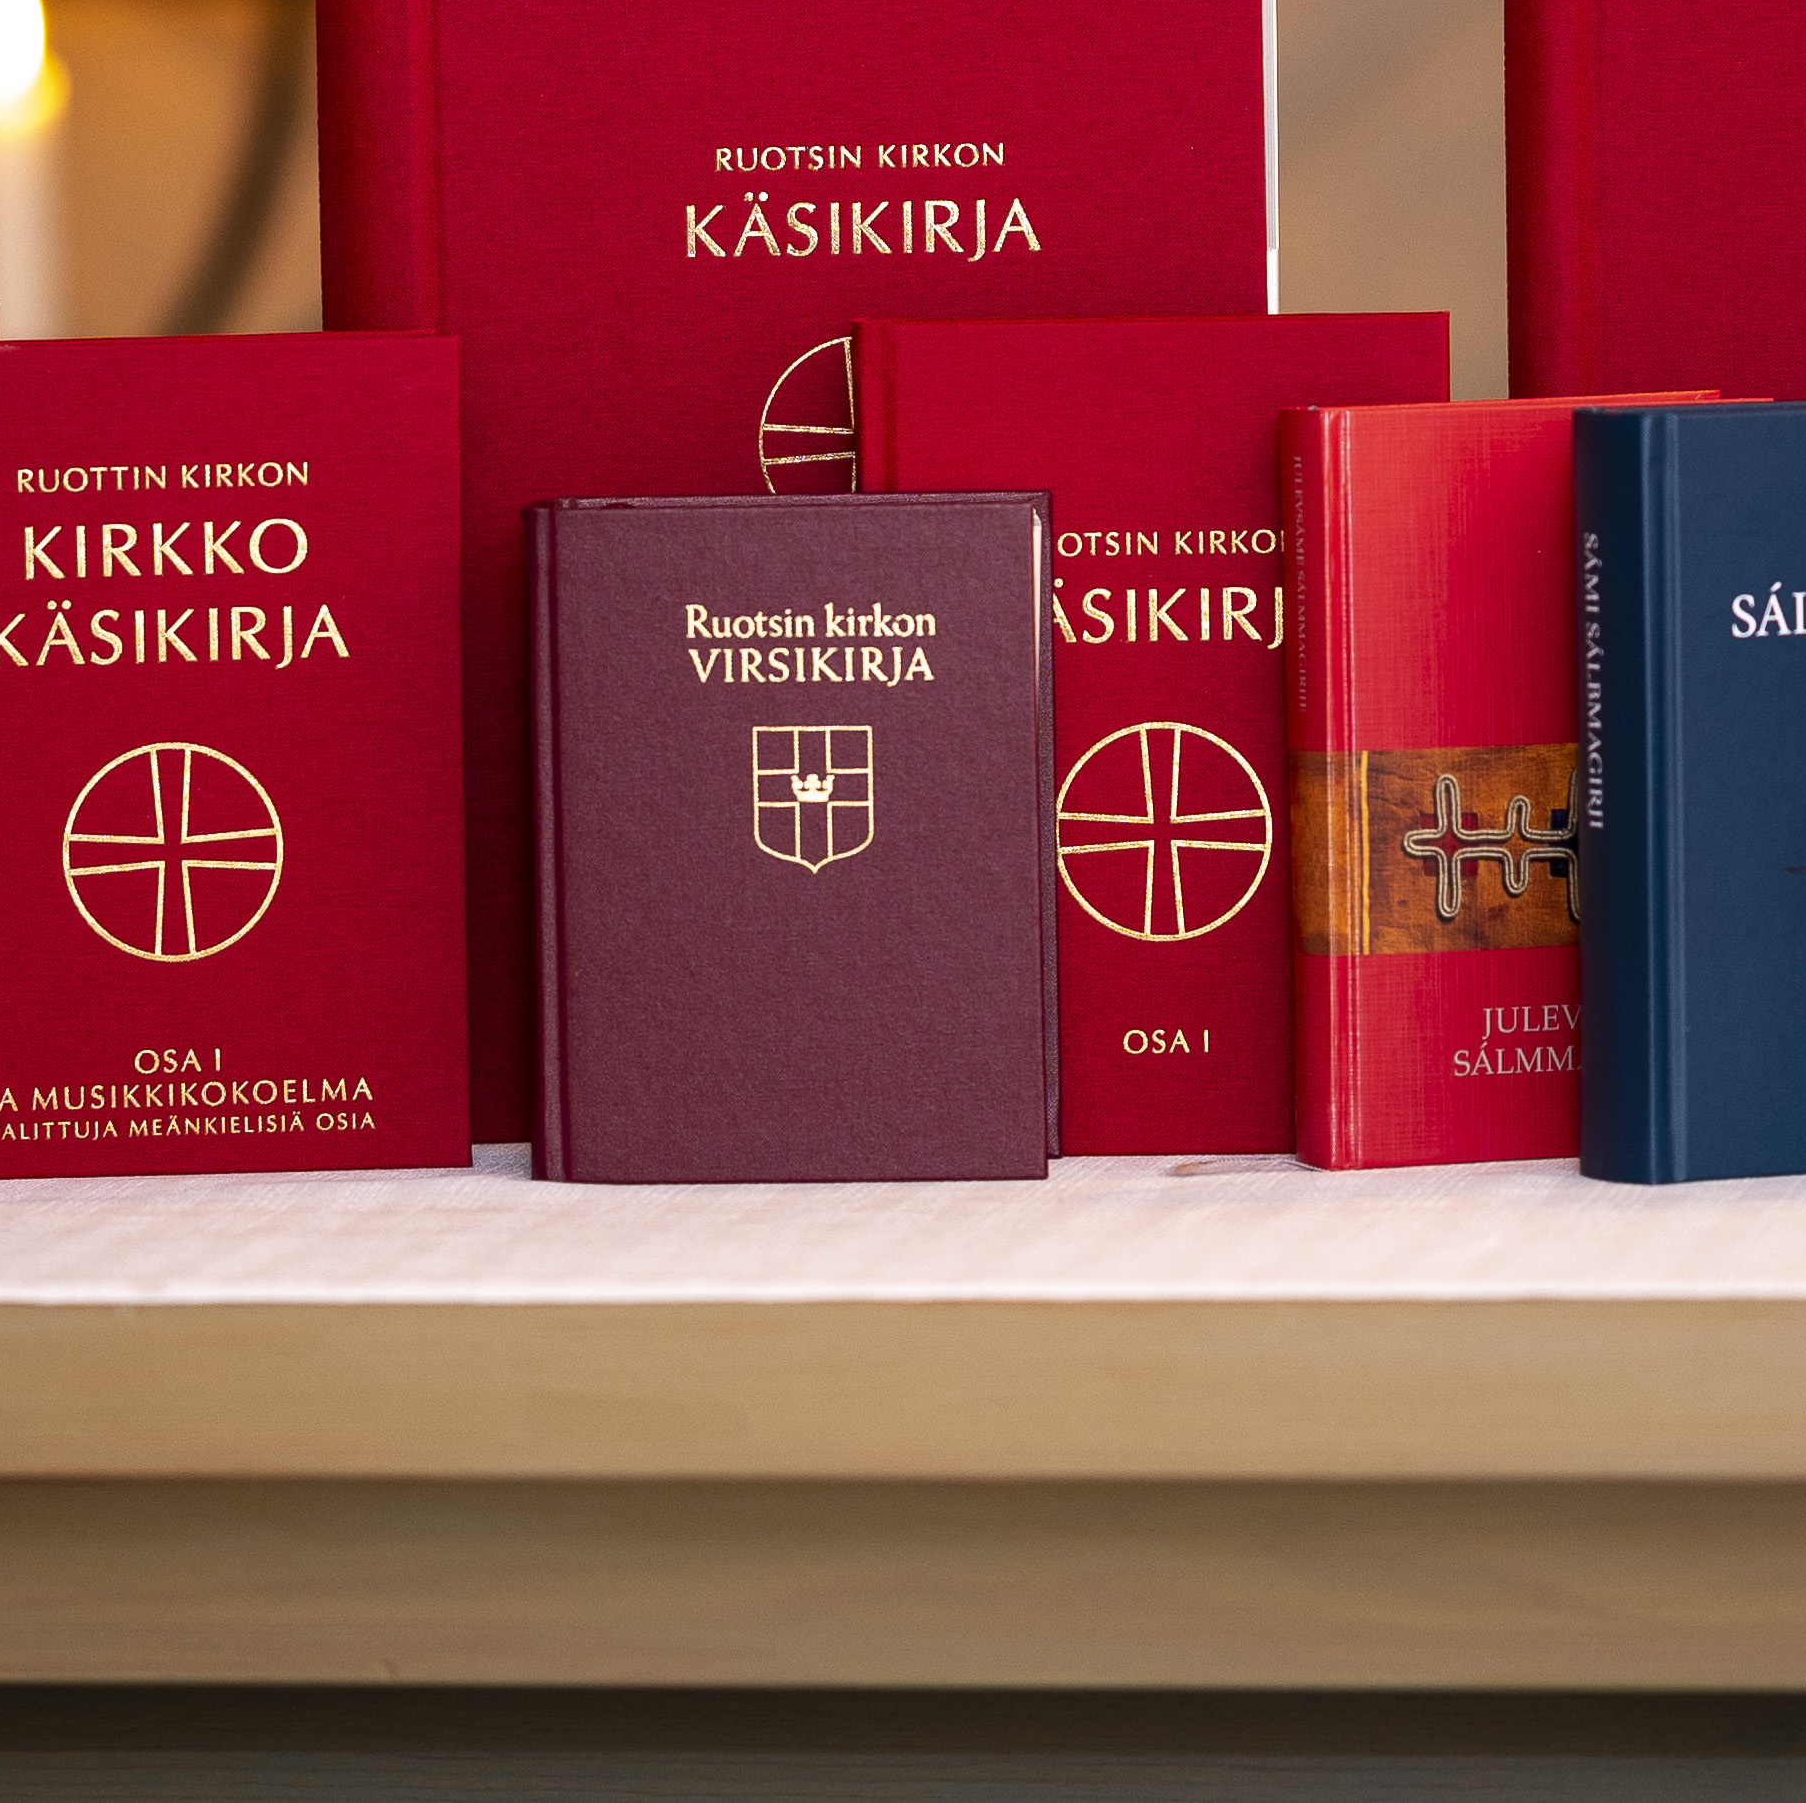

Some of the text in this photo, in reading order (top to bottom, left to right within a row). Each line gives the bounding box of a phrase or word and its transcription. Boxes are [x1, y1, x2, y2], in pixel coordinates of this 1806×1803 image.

[716, 142, 1004, 172] RUOTSIN KIRKON
[686, 191, 1041, 263] KÄSIKIRJA
[17, 461, 308, 493] RUOTTIN KIRKON
[24, 518, 308, 581] KIRKKO
[685, 602, 936, 639] Ruotsin kirkon
[688, 646, 935, 688] VIRSIKIRJA
[1584, 532, 1605, 828] SÁMI SÁLBMAGIRJI
[1122, 1028, 1209, 1055] OSA I
[1453, 1040, 1582, 1077] SÁLMM
[134, 1047, 221, 1075] OSA I
[32, 1077, 373, 1110] MUSIKKIKOKOELMA
[128, 1111, 305, 1138] MEÄNKIELISIÄ
[315, 1111, 376, 1131] OSIA
